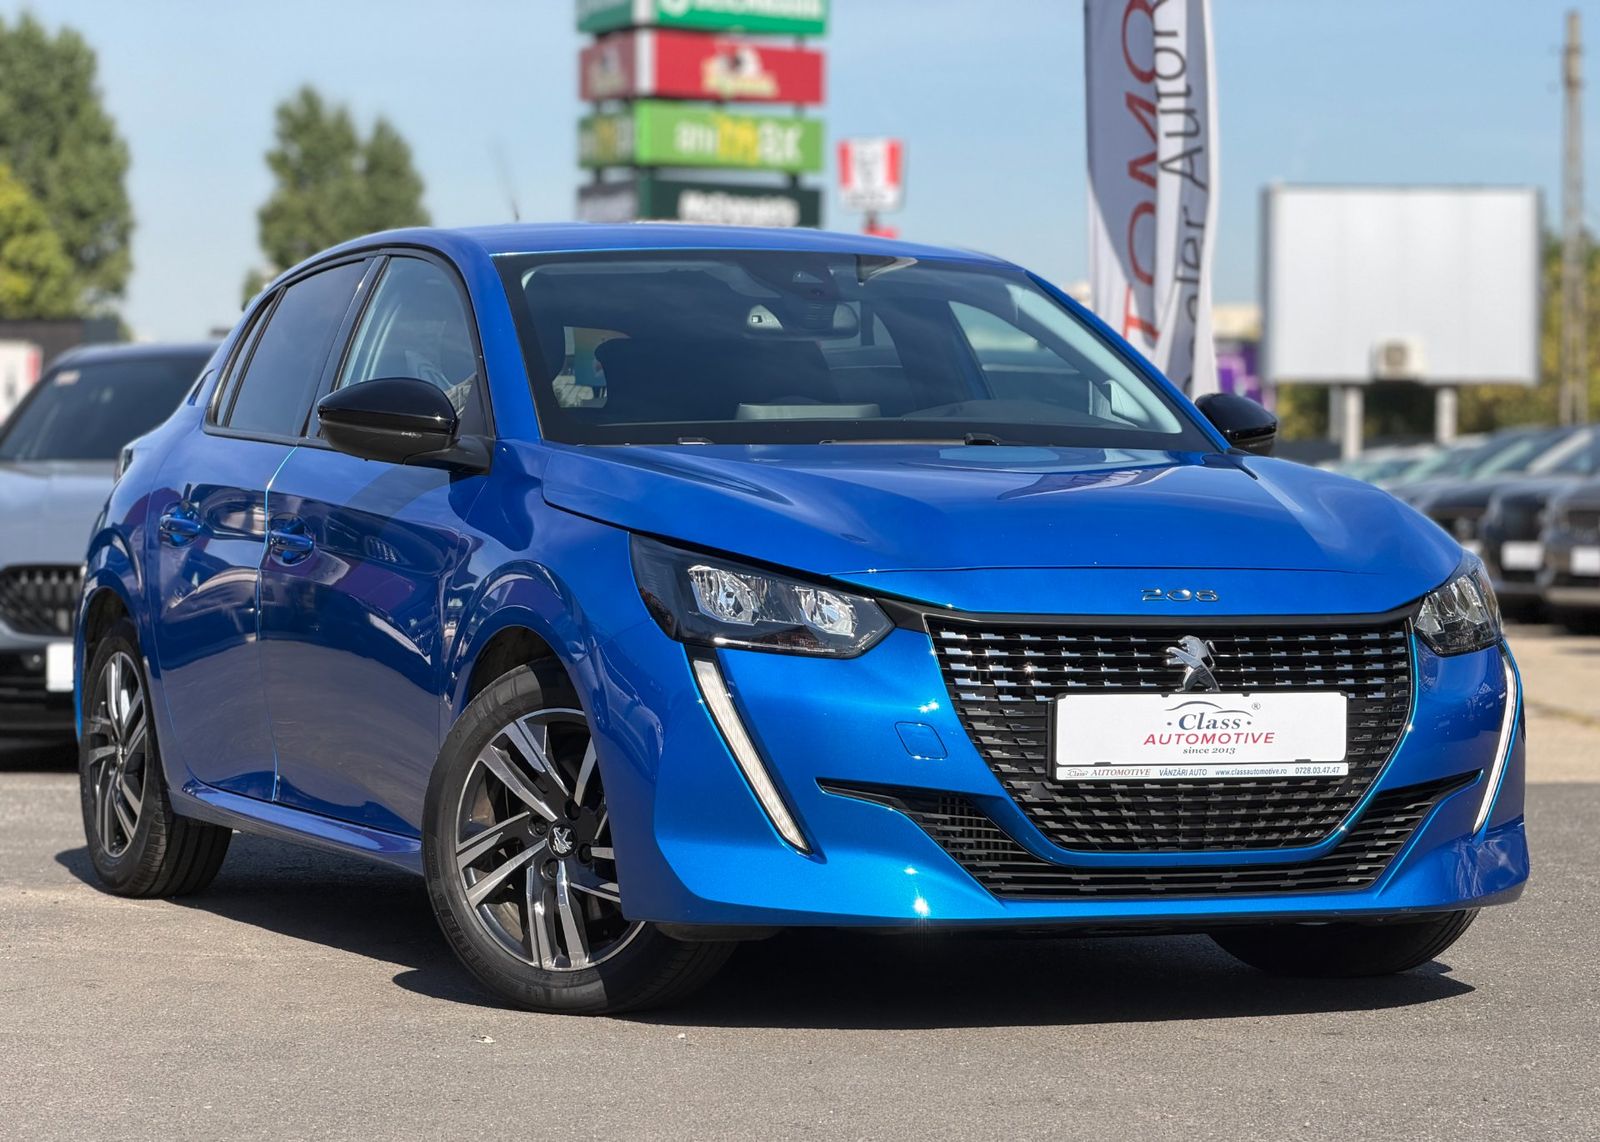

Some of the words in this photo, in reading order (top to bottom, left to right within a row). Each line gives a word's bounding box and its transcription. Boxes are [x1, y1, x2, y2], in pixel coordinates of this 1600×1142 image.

[1140, 588, 1219, 602] 208
[1178, 712, 1242, 731] Class
[1143, 732, 1276, 746] AUTOMOTIVE
[1183, 747, 1210, 755] since
[1211, 747, 1236, 756] 2013
[1090, 768, 1151, 777] AUTOMOTIVE
[1189, 768, 1207, 777] AUTO
[1215, 767, 1287, 776] www.classautomotive.ro
[1294, 766, 1341, 775] 0728.03.47.47
